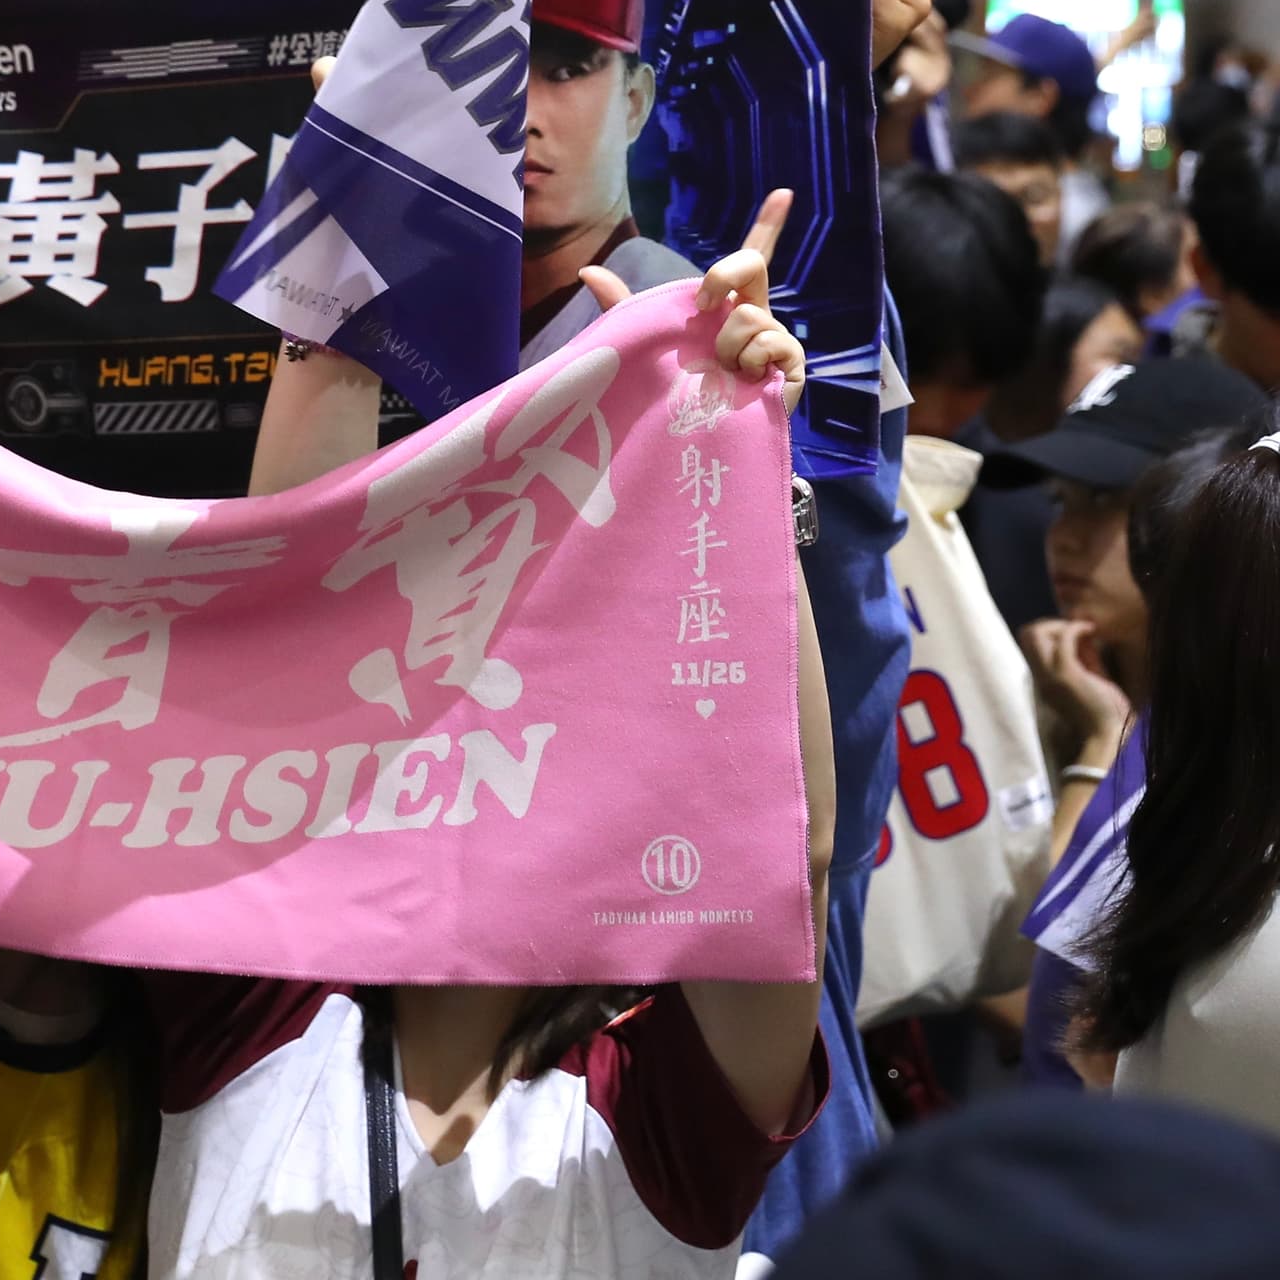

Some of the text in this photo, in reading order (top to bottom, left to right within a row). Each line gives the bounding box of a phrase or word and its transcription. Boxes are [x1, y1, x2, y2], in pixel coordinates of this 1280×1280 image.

[674, 443, 731, 645] 射手座
[671, 659, 747, 687] 11/26
[699, 909, 754, 924] MONKEYS
